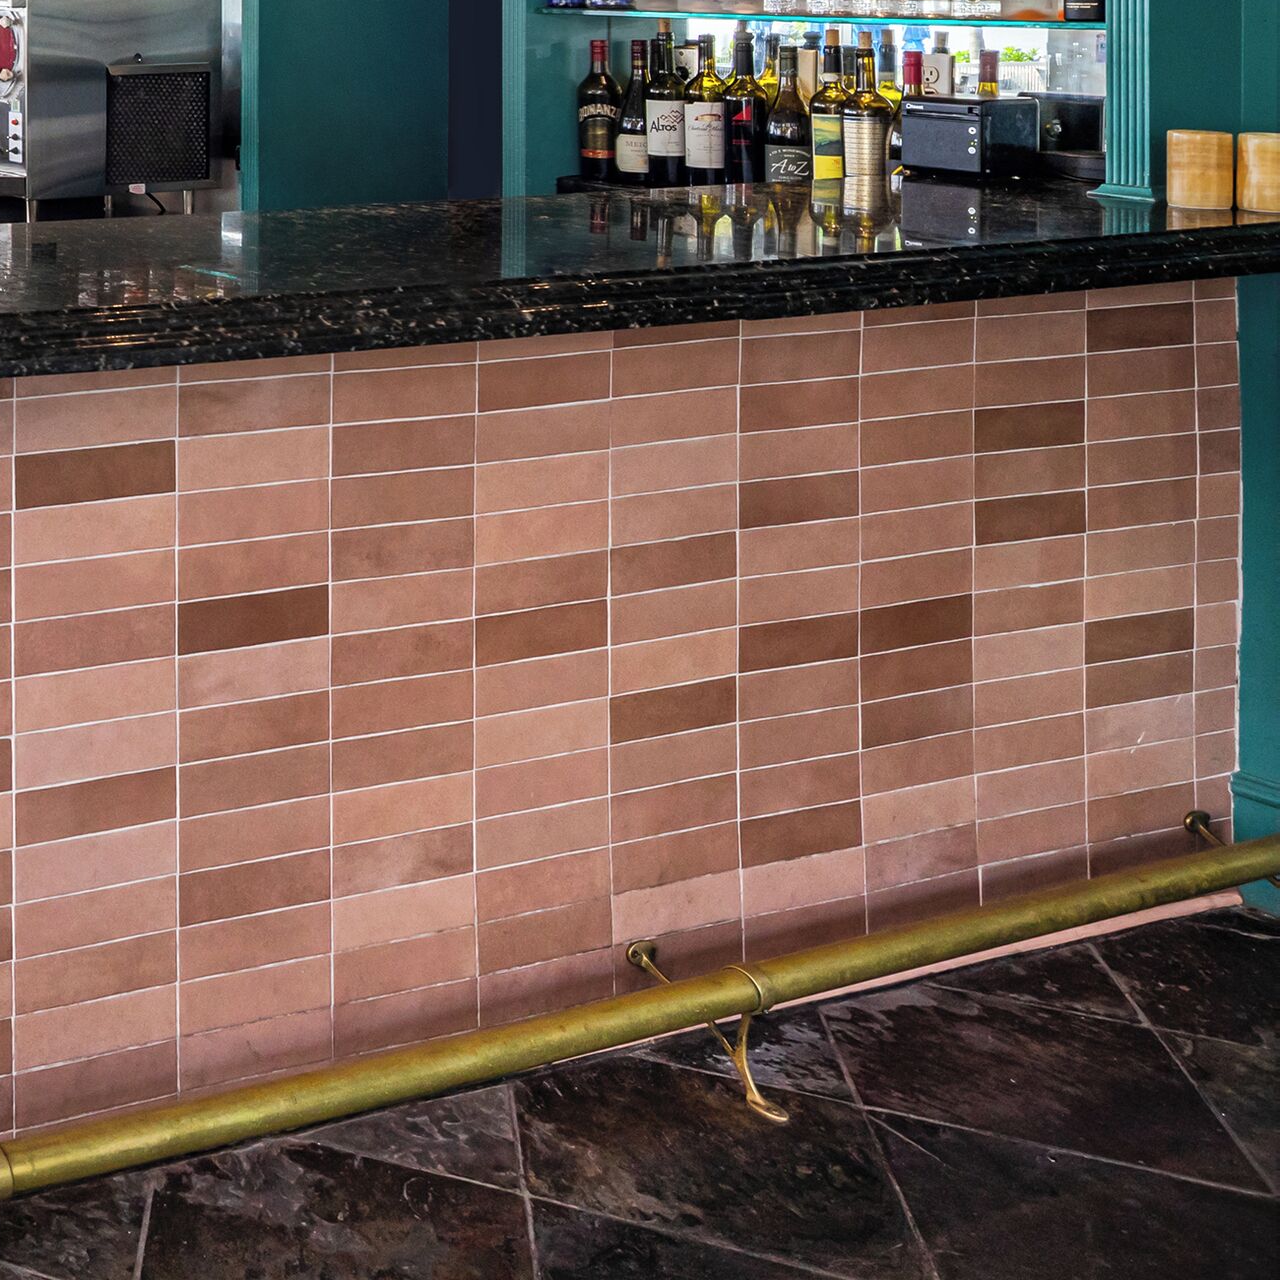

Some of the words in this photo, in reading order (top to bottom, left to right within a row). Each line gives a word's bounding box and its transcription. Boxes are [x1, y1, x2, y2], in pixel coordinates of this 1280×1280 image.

[770, 159, 788, 174] A
[788, 164, 797, 172] to
[794, 161, 810, 176] Z
